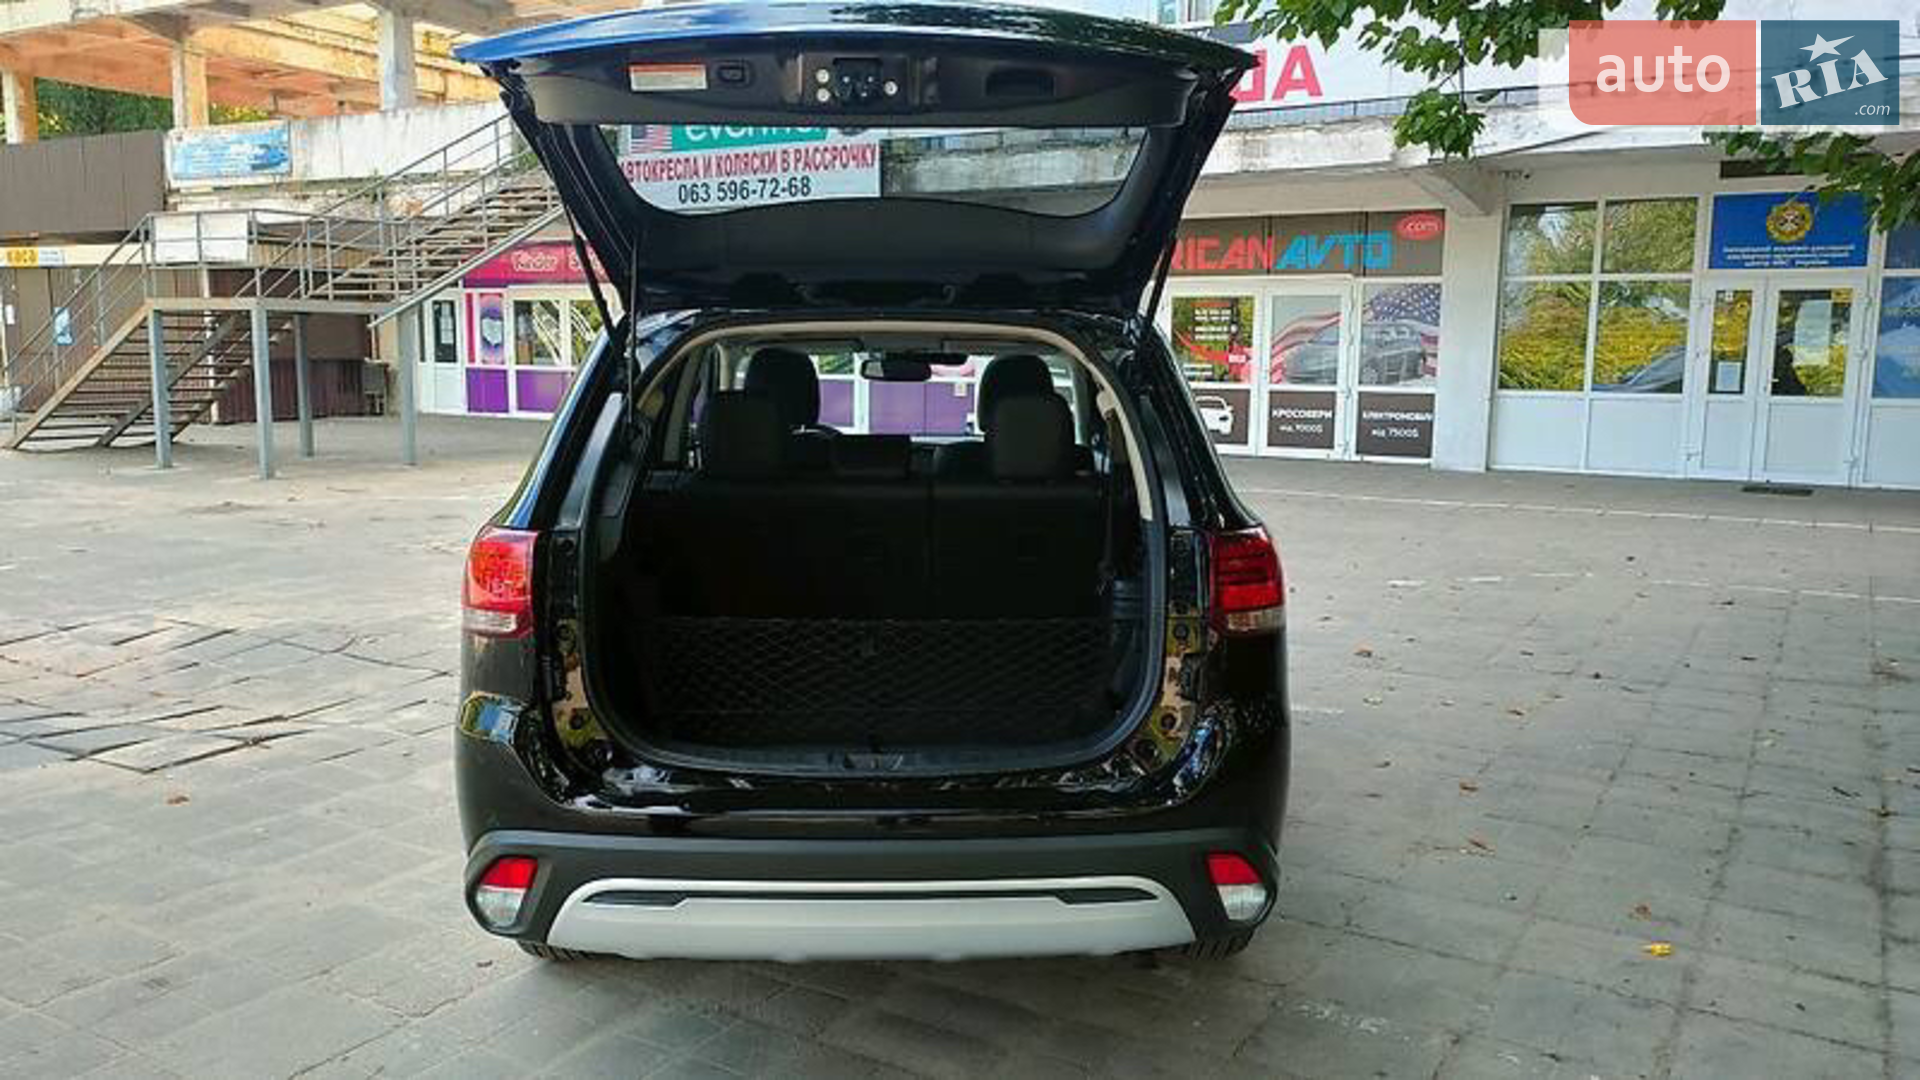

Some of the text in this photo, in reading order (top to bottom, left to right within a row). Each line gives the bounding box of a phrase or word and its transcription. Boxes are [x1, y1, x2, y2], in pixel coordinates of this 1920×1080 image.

[715, 150, 778, 177] КОЛЯСКИ
[794, 143, 877, 170] РАССРОЧКУ
[678, 175, 812, 204] 063 596-72-68
